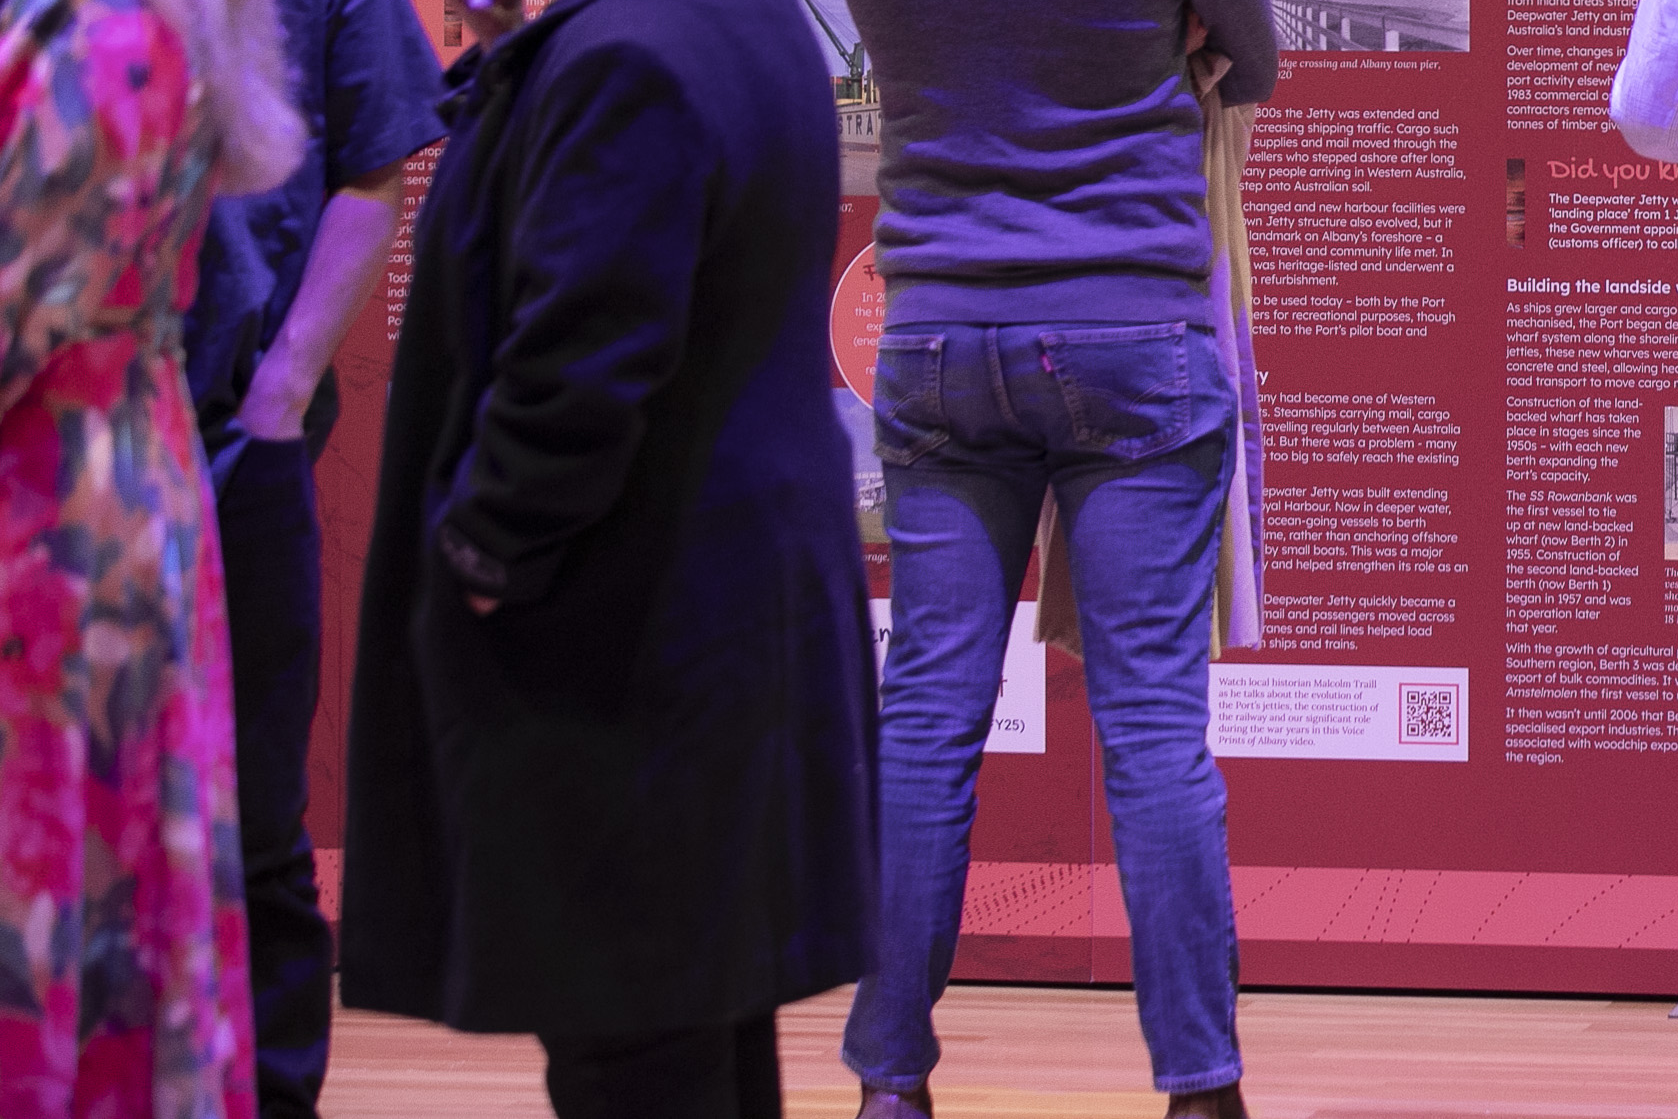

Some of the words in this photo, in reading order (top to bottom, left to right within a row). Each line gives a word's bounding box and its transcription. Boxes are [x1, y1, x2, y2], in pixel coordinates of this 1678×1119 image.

[1254, 107, 1282, 119] 800s
[1284, 107, 1303, 119] the
[1305, 107, 1335, 122] Jetty
[1337, 111, 1360, 119] was
[1362, 108, 1415, 119] extended
[1416, 108, 1439, 120] and
[1547, 157, 1598, 179] Did
[1602, 163, 1650, 189] you
[1506, 278, 1570, 297] Building
[1574, 279, 1600, 294] the
[1605, 279, 1671, 294] landside
[1505, 397, 1576, 408] Construction
[1578, 397, 1590, 409] of
[1593, 397, 1612, 409] the
[1614, 397, 1643, 409] land-
[1505, 490, 1526, 502] The
[1529, 490, 1544, 502] SS
[1546, 491, 1612, 503] Rowanbank
[1614, 494, 1637, 503] was
[1664, 614, 1674, 625] 18
